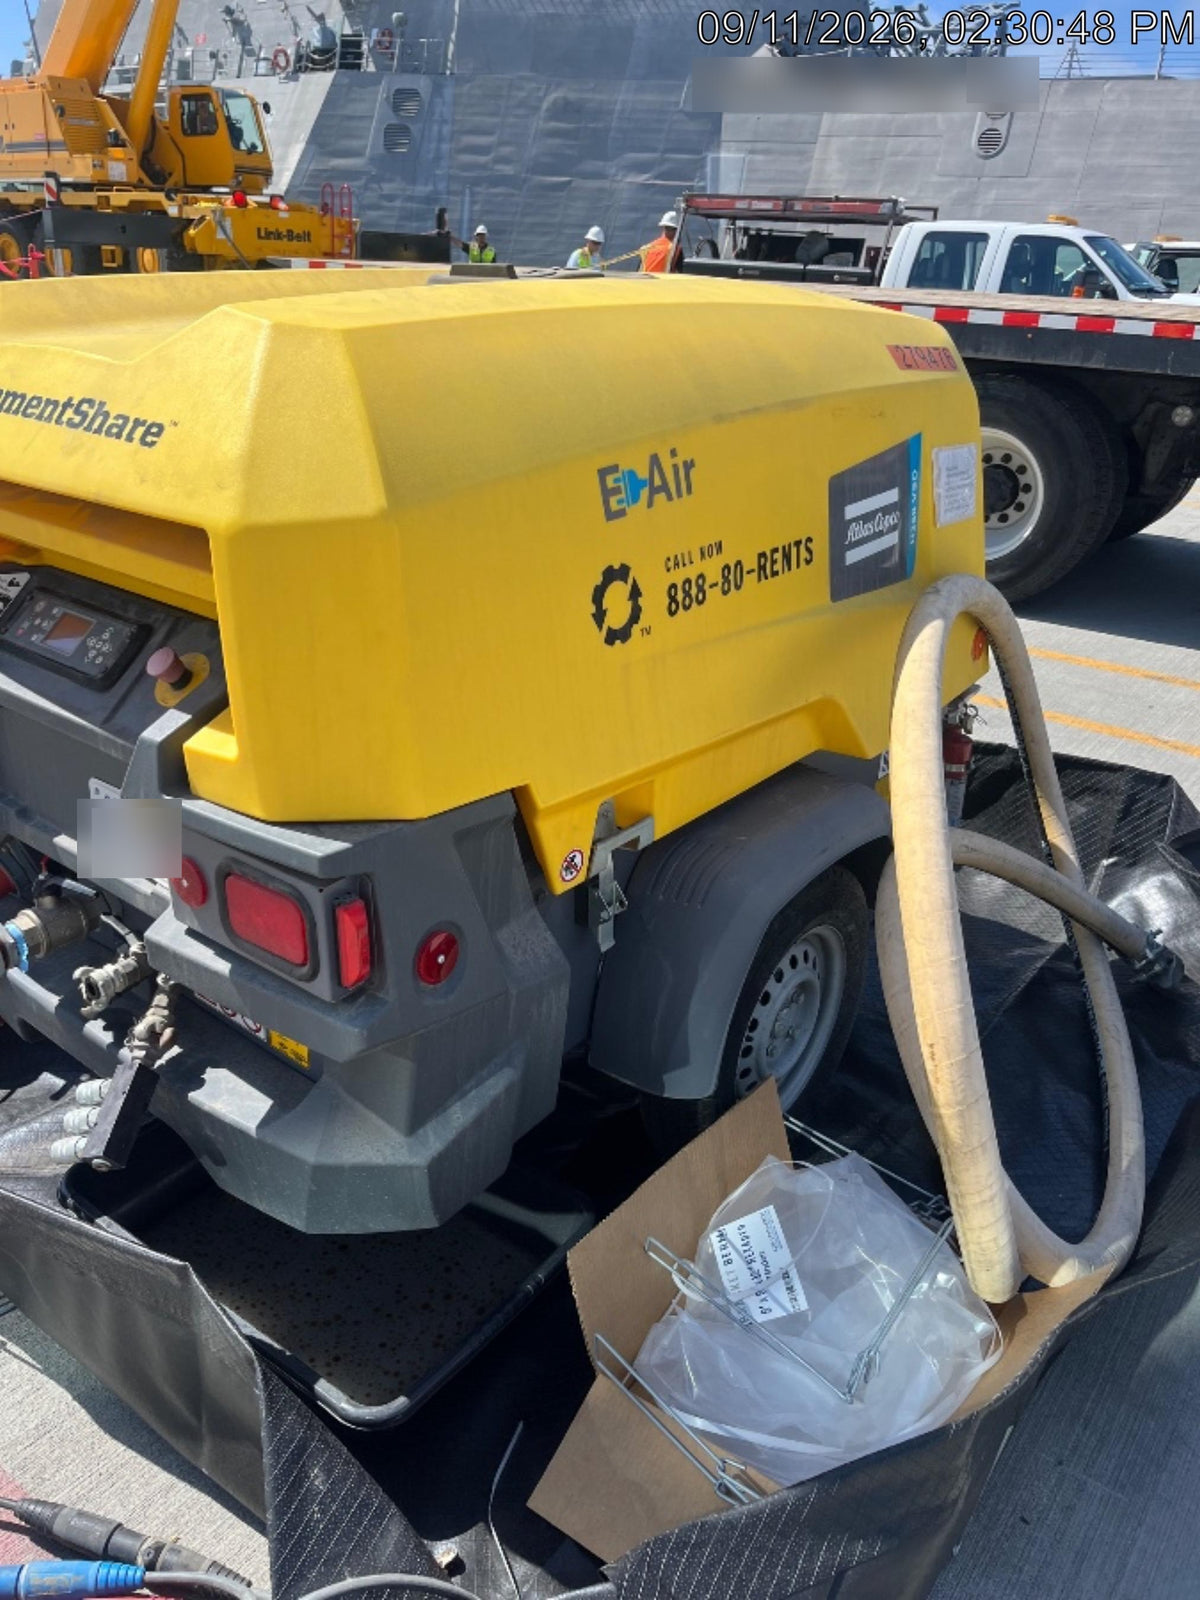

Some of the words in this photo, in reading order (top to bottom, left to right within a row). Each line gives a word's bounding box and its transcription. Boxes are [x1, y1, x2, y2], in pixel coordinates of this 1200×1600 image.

[256, 226, 312, 243] Link-Belt
[665, 550, 694, 573] CALL
[700, 540, 723, 562] NOW
[667, 536, 814, 618] 888-80-RENTS
